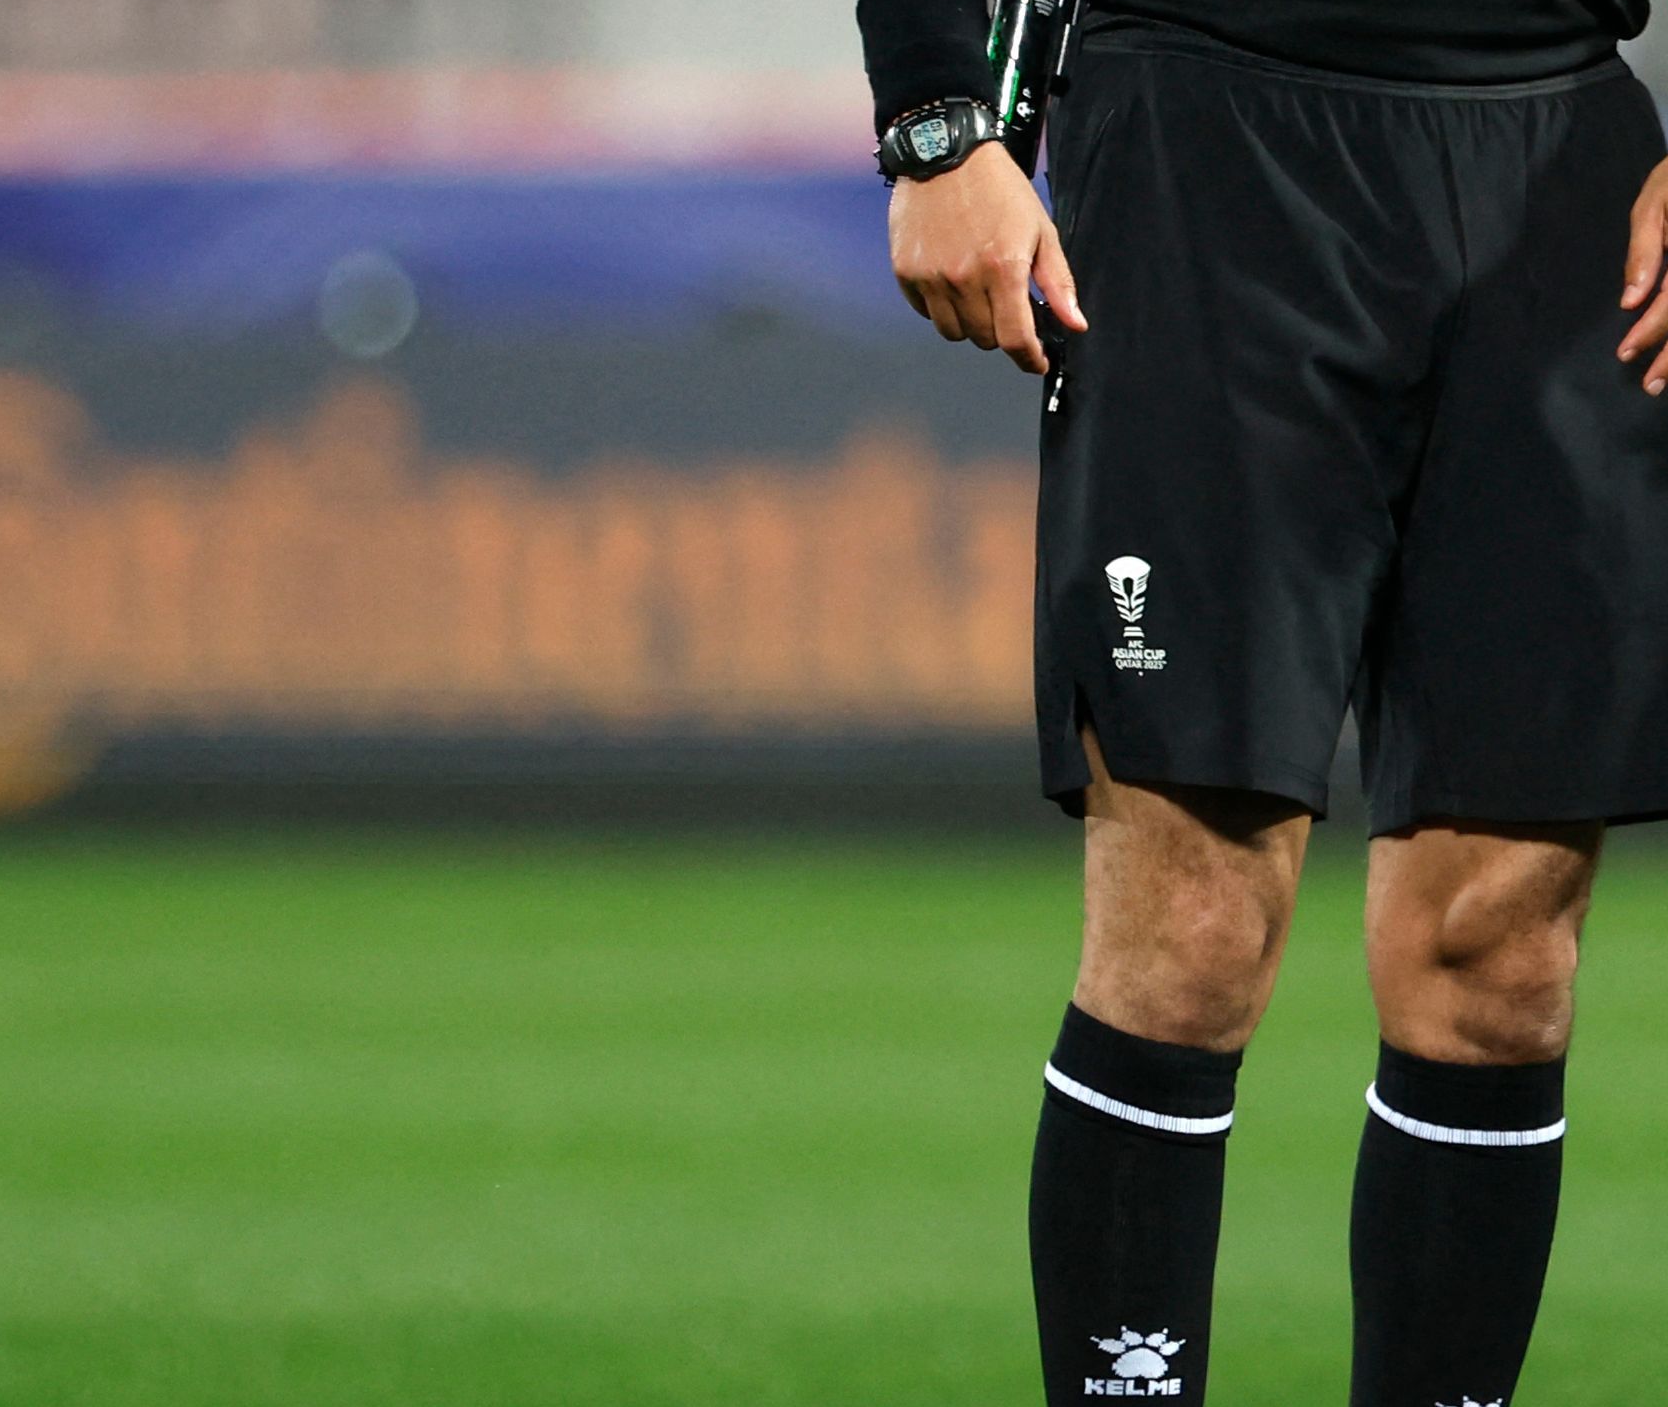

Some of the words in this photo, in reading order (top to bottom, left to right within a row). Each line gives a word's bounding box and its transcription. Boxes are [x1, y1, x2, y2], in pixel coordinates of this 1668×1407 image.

[1128, 639, 1144, 649] AFC
[1112, 647, 1143, 660] ASIAN
[1143, 648, 1166, 660] CUP
[1115, 658, 1143, 670] QATAR
[1084, 1377, 1181, 1396] KELME
